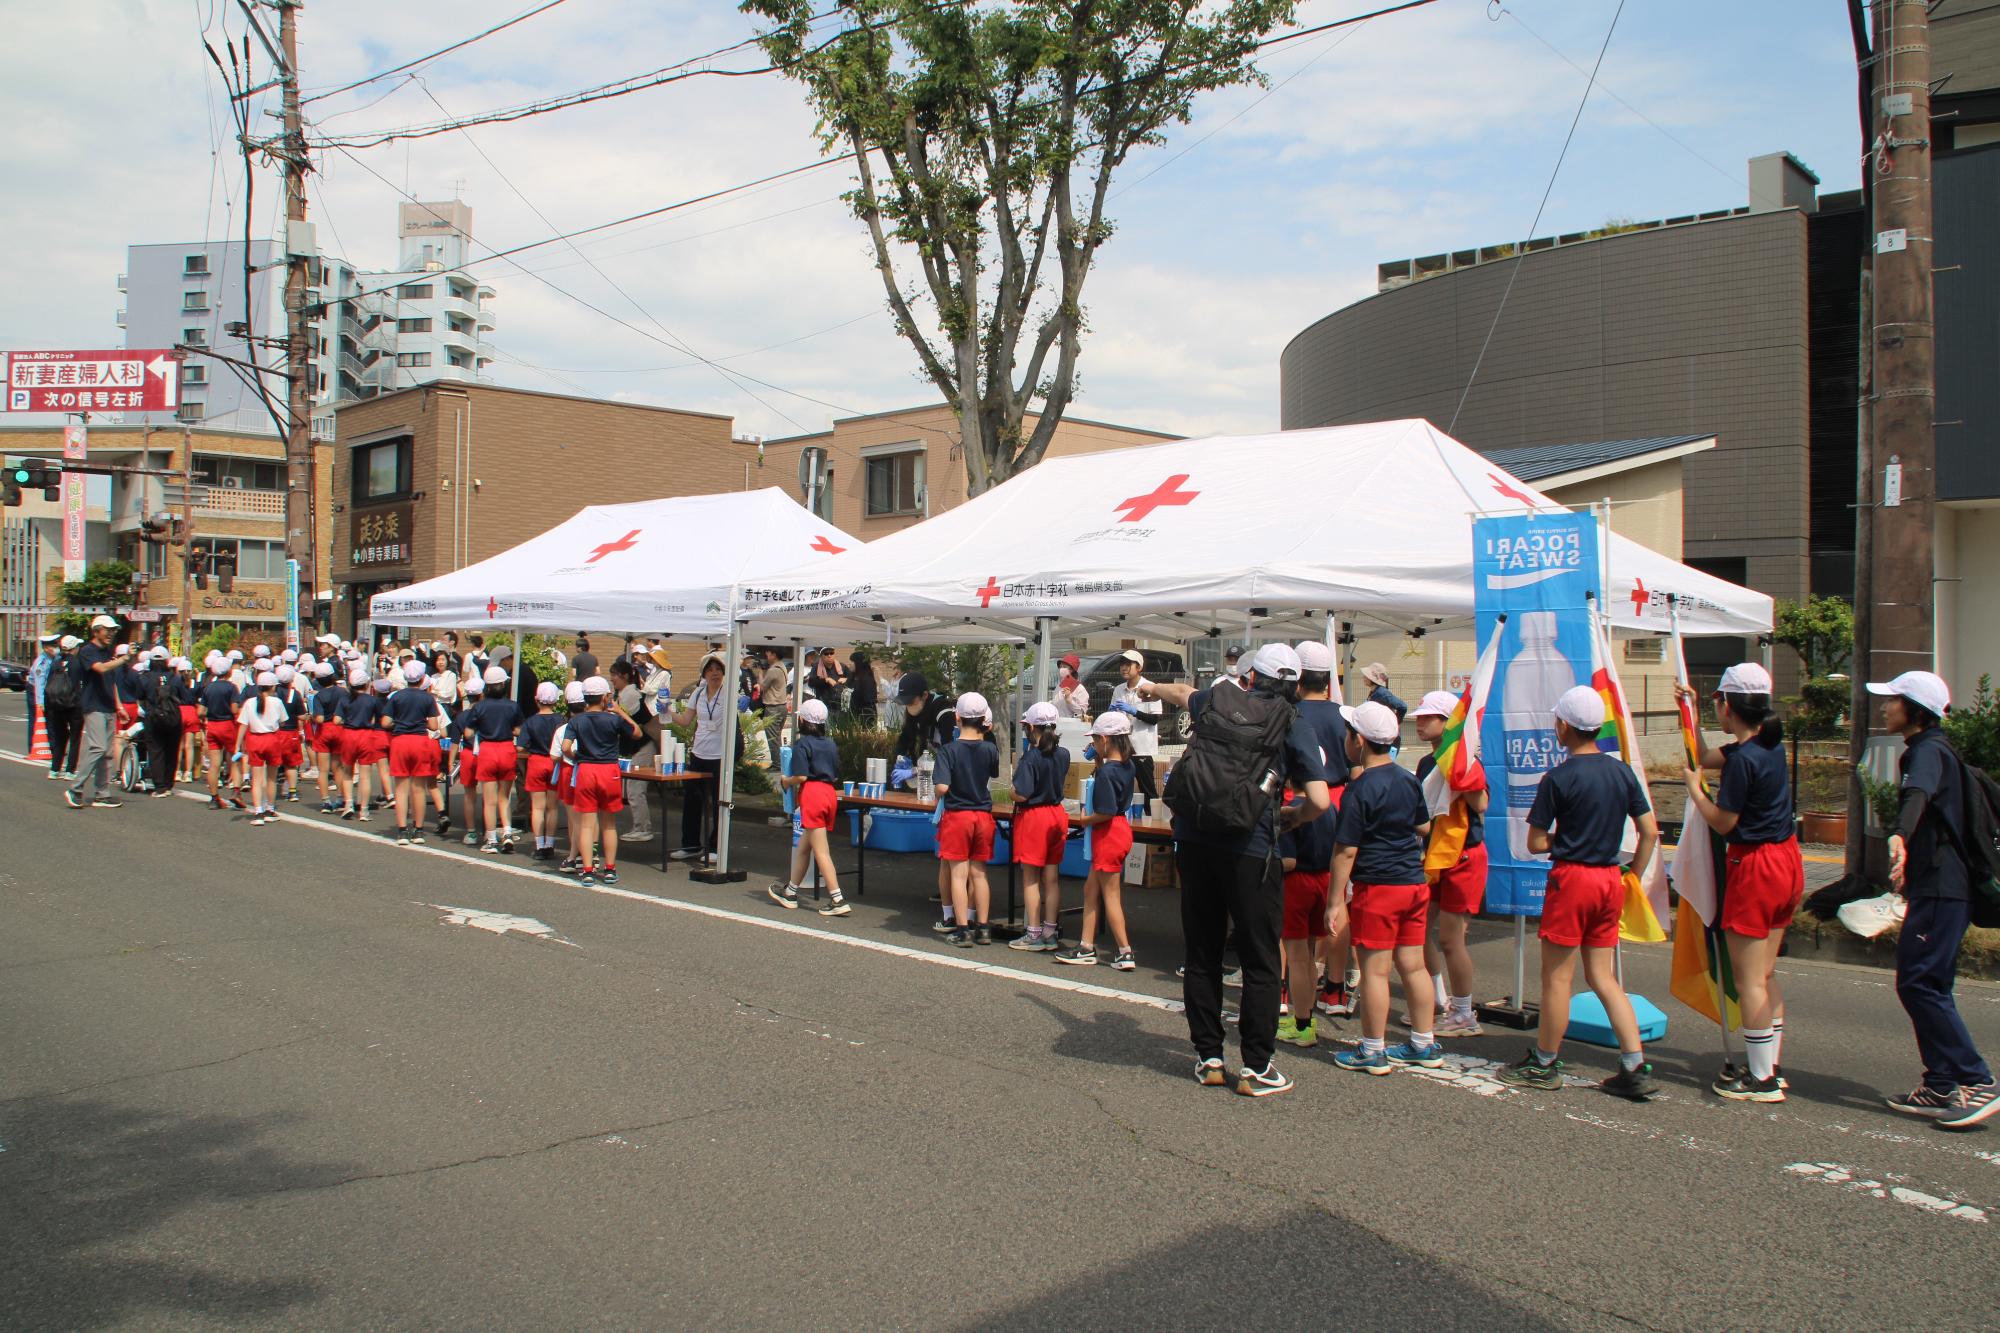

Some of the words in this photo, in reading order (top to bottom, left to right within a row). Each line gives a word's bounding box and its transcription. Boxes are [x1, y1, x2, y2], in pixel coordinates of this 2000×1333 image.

[15, 363, 141, 386] 新妻産婦人科
[15, 392, 27, 407] P
[44, 391, 144, 407] 次の信号左折
[360, 511, 399, 544] 漢方薬
[360, 544, 400, 562] 小野寺薬局
[1003, 583, 1068, 598] 日本赤十字社
[1075, 580, 1123, 593] 福島県支部
[203, 596, 275, 610] SANKAKU
